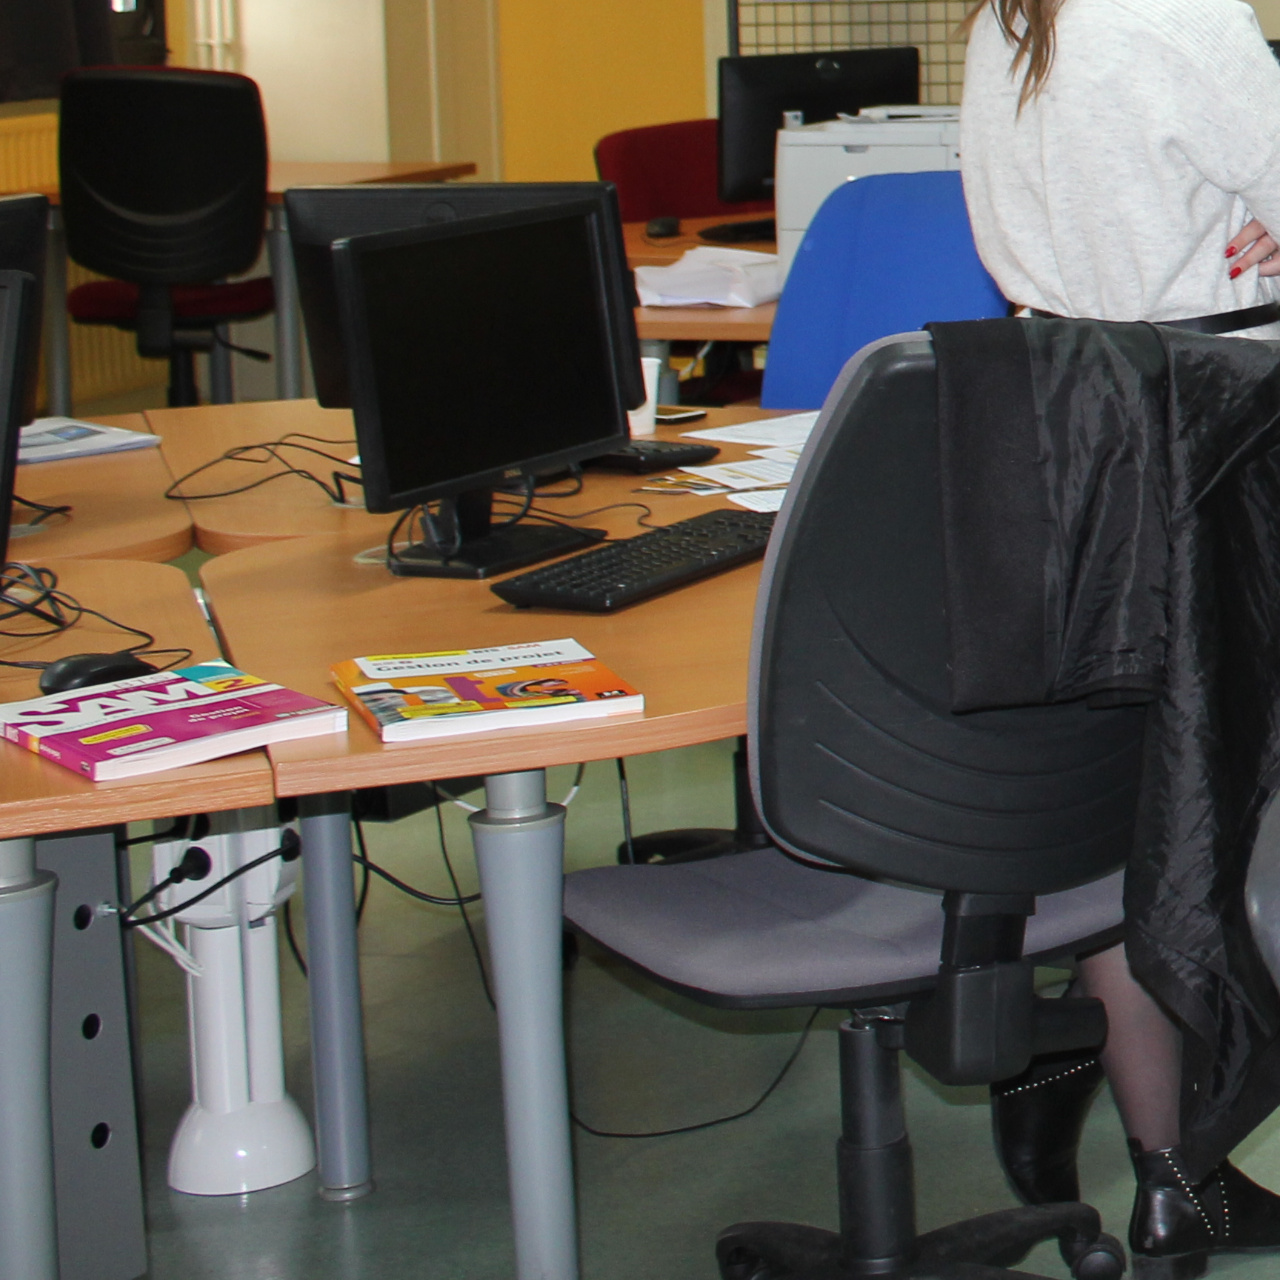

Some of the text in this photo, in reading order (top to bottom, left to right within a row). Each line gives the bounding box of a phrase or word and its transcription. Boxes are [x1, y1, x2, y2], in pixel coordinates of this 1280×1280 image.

[376, 660, 460, 672] Gestion
[466, 657, 493, 665] de
[500, 650, 565, 662] projet
[113, 673, 170, 689] BTS
[16, 680, 220, 736] SAM
[213, 677, 254, 690] 2
